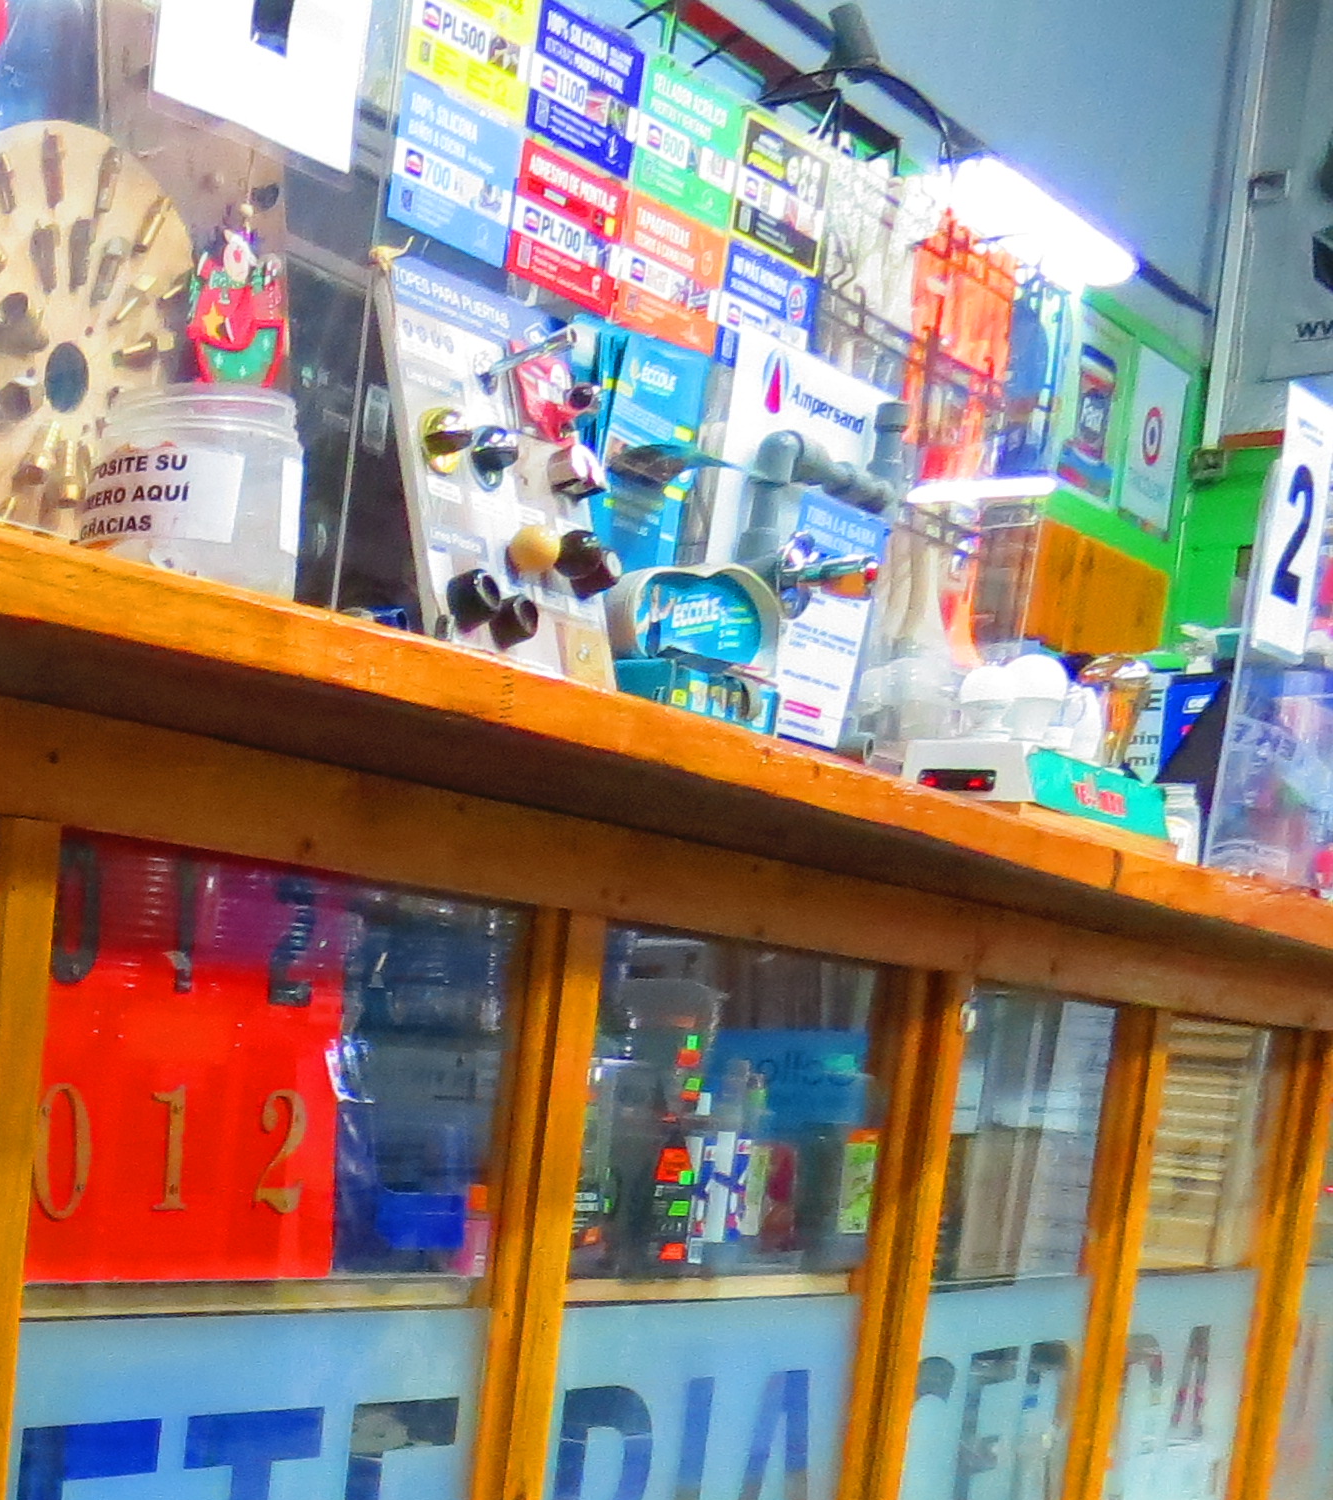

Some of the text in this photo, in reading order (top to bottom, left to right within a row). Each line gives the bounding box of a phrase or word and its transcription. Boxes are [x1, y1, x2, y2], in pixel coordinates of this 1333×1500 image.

[442, 12, 486, 55] PL500
[425, 157, 451, 191] 700
[542, 215, 581, 253] PL700
[431, 282, 460, 309] PARA
[792, 384, 866, 435] Ampersand
[155, 454, 189, 472] SU
[131, 480, 191, 503] AQUÍ
[79, 515, 153, 541] GRACIAS
[1270, 464, 1315, 606] 2
[150, 1084, 188, 1213] 1
[251, 1088, 309, 1215] 2
